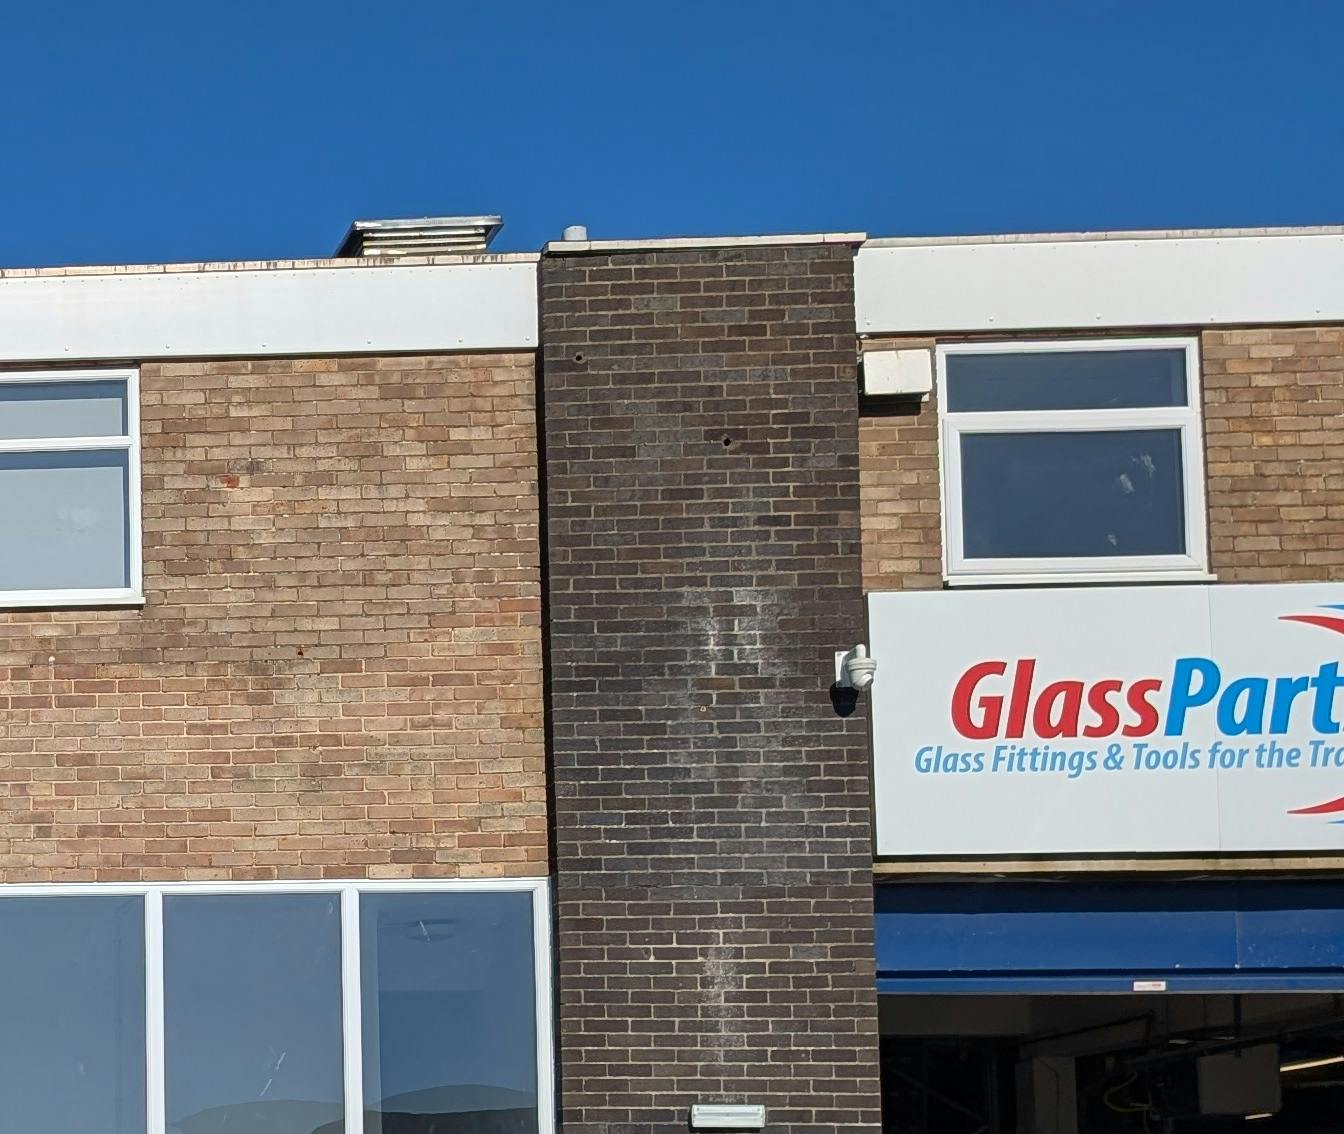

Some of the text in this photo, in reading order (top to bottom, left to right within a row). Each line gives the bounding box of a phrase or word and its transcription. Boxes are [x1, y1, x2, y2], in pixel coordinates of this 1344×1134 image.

[950, 657, 1344, 740] GlassPart
[914, 745, 985, 774] Glass
[992, 743, 1098, 779] Fittings
[1103, 744, 1125, 771] &
[1132, 742, 1201, 771] Tools
[1206, 741, 1249, 770] for
[1255, 740, 1301, 769] the
